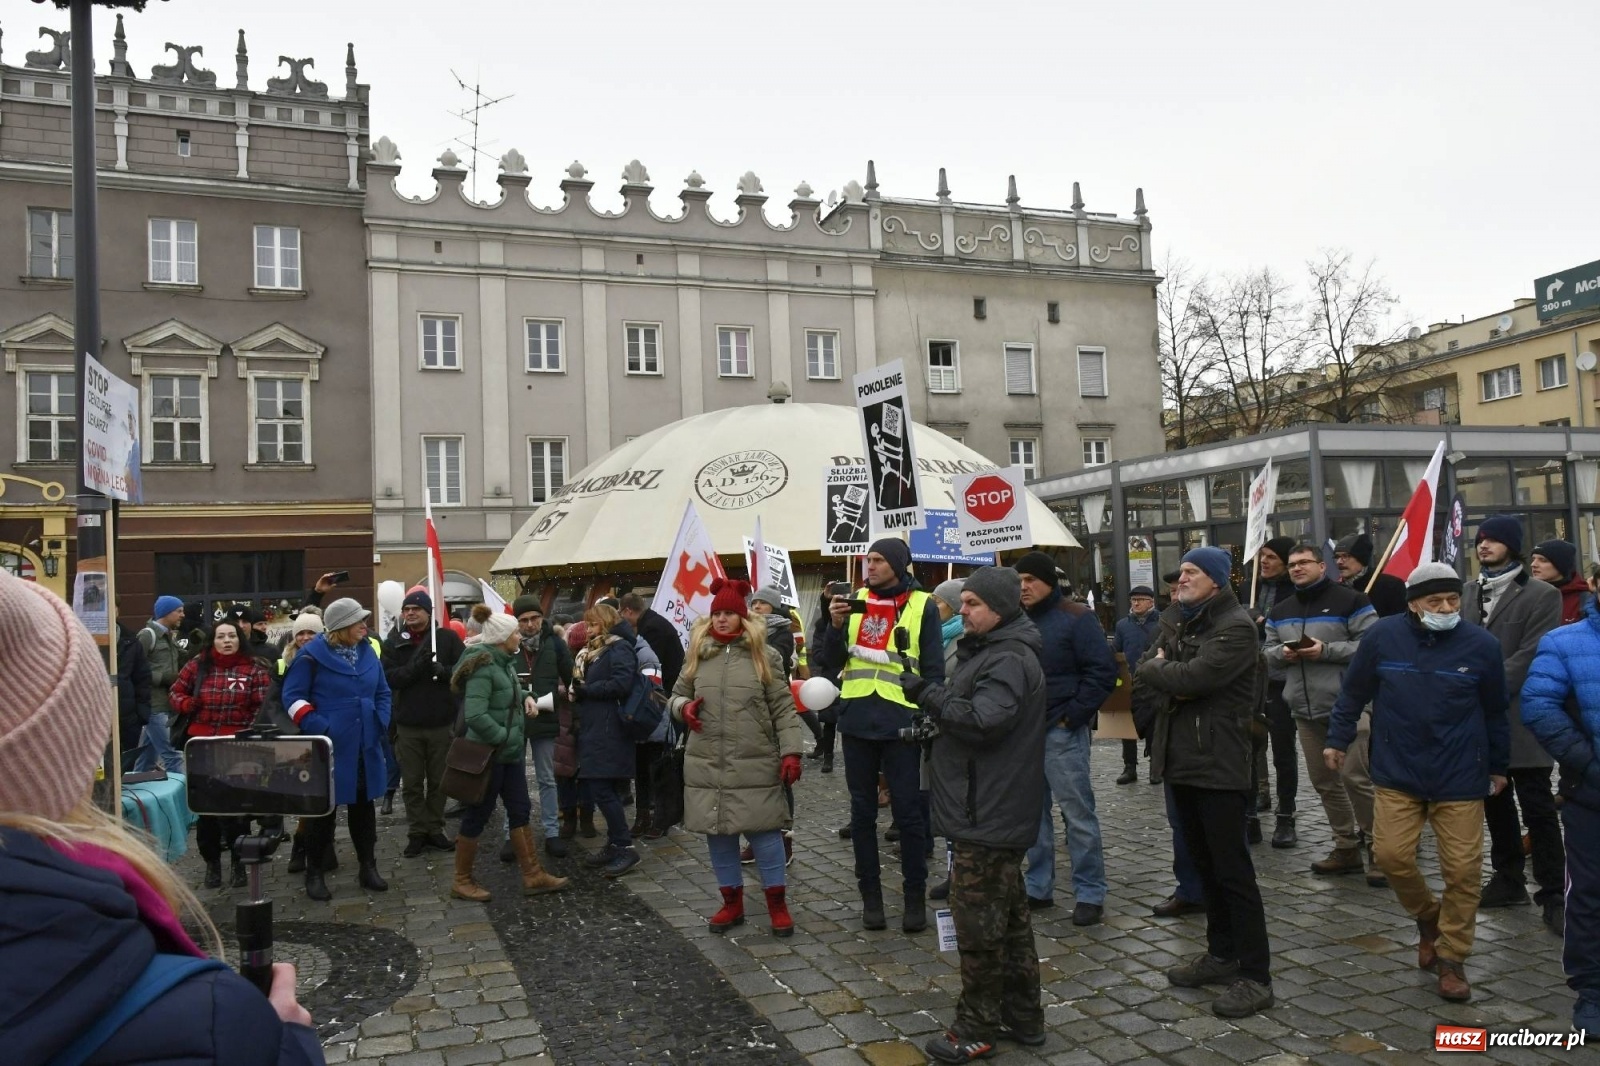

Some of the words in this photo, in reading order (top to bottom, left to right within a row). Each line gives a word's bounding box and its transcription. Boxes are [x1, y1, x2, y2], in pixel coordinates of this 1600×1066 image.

[1575, 276, 1600, 294] Mc
[1542, 301, 1560, 312] 300
[1562, 299, 1571, 307] m
[88, 365, 109, 396] STOP
[858, 372, 903, 398] POKOLENIE
[87, 439, 107, 461] COVID
[703, 454, 740, 475] BROWAR
[830, 466, 867, 475] SŁUŻBA
[743, 470, 780, 486] 1567
[706, 485, 771, 507] RACIBÓRZ
[966, 489, 1011, 508] STOP
[883, 511, 917, 529] KAPUT!
[966, 525, 1023, 538] PASZPORTOM
[747, 540, 784, 556] MDIA
[831, 544, 866, 553] KAPUT!
[970, 535, 1022, 547] COVIDOWYM
